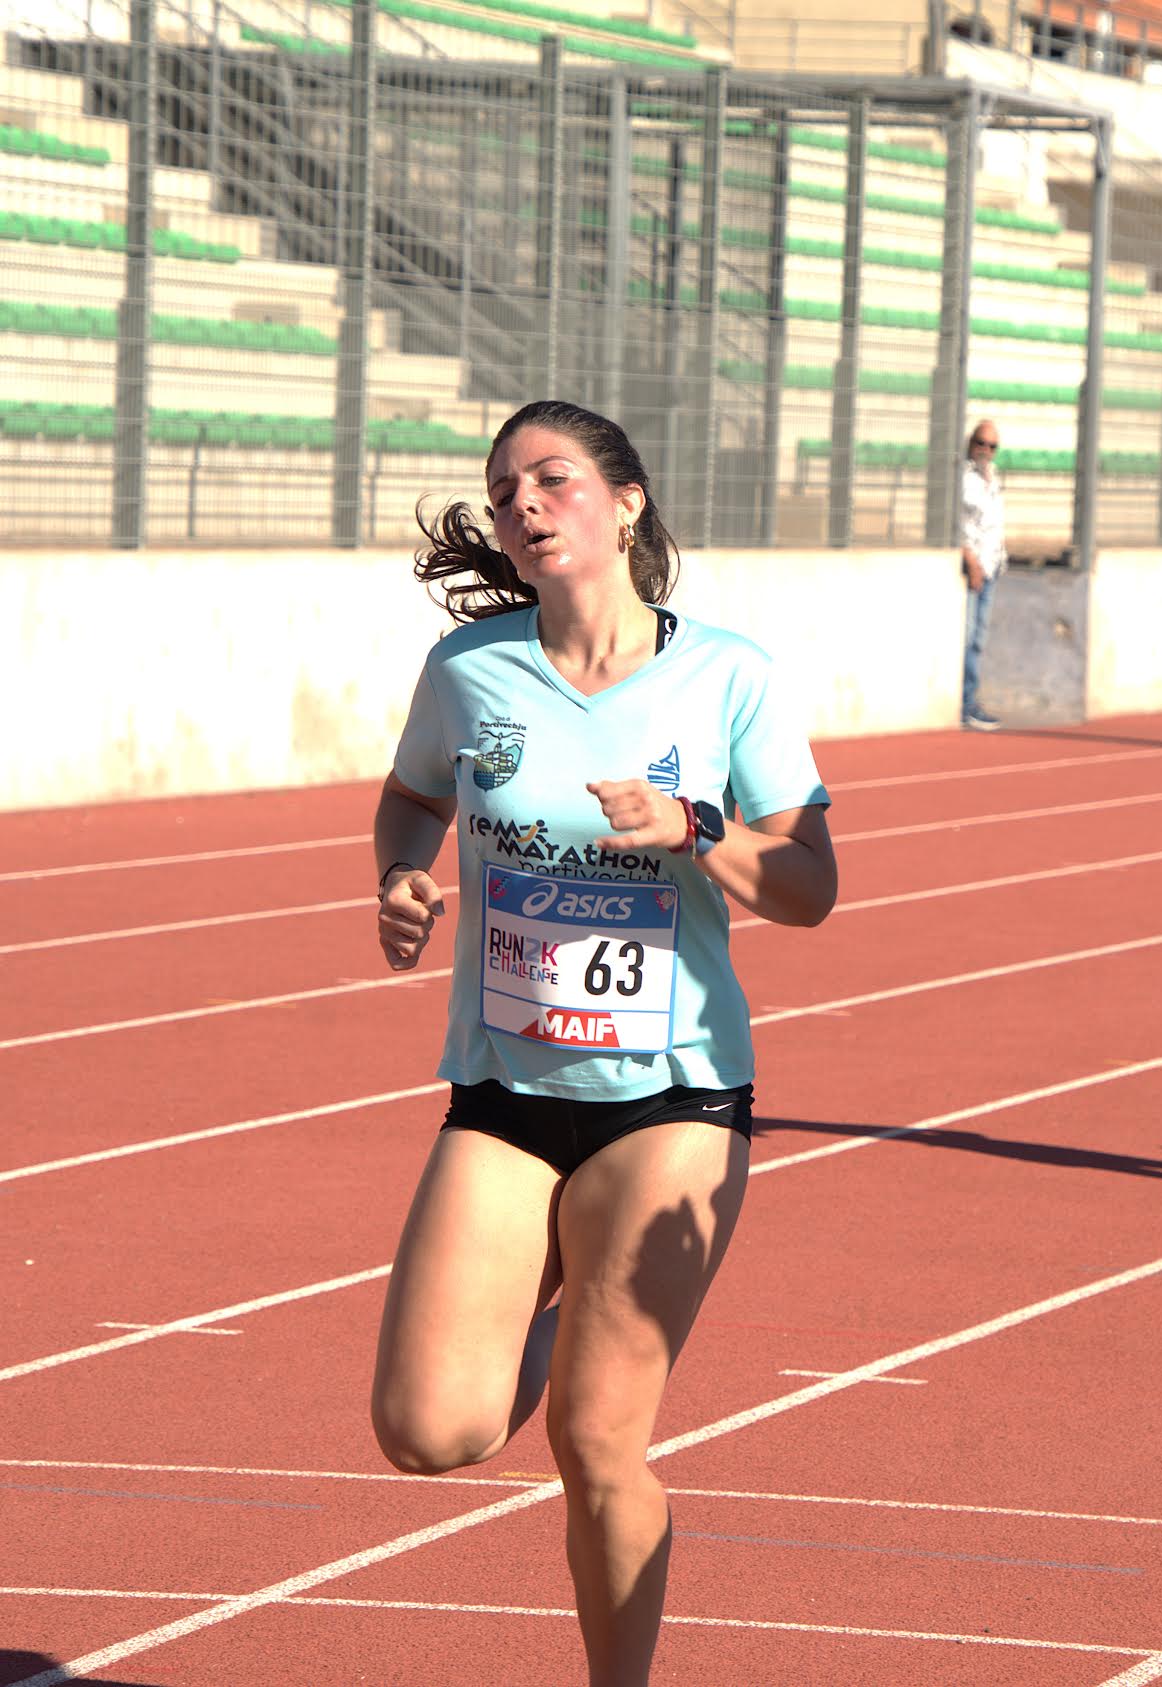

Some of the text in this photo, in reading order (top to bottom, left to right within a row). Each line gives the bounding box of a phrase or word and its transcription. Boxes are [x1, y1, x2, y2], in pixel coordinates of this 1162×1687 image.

[489, 950, 559, 985] CHALLENGE
[584, 940, 644, 997] 63
[537, 1013, 618, 1043] MAIF
